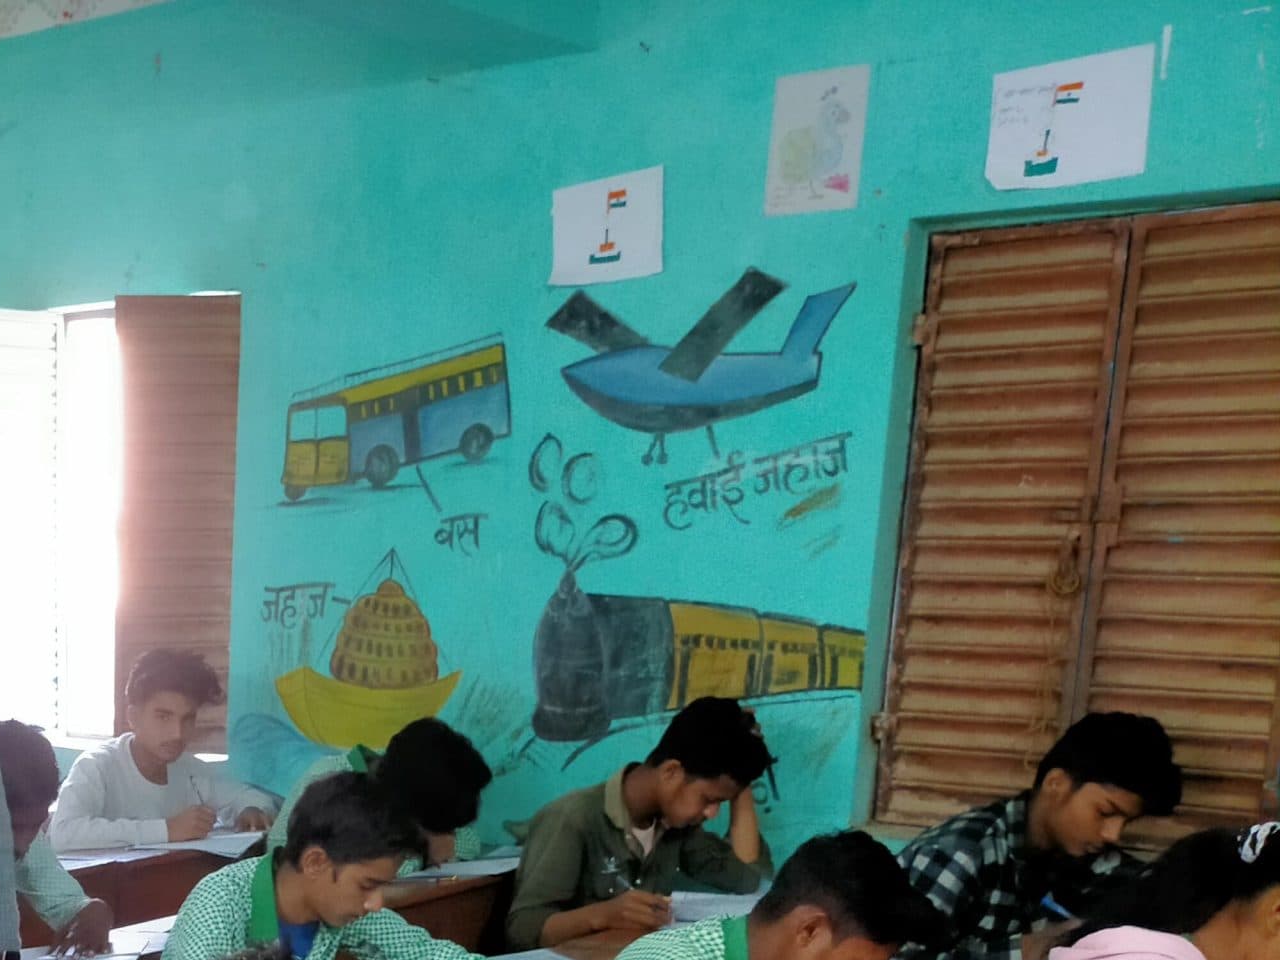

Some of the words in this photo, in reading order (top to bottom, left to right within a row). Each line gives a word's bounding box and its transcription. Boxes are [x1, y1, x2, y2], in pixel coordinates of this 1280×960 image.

[663, 449, 752, 528] हवाई
[753, 431, 853, 499] जहाज
[433, 512, 487, 553] बस
